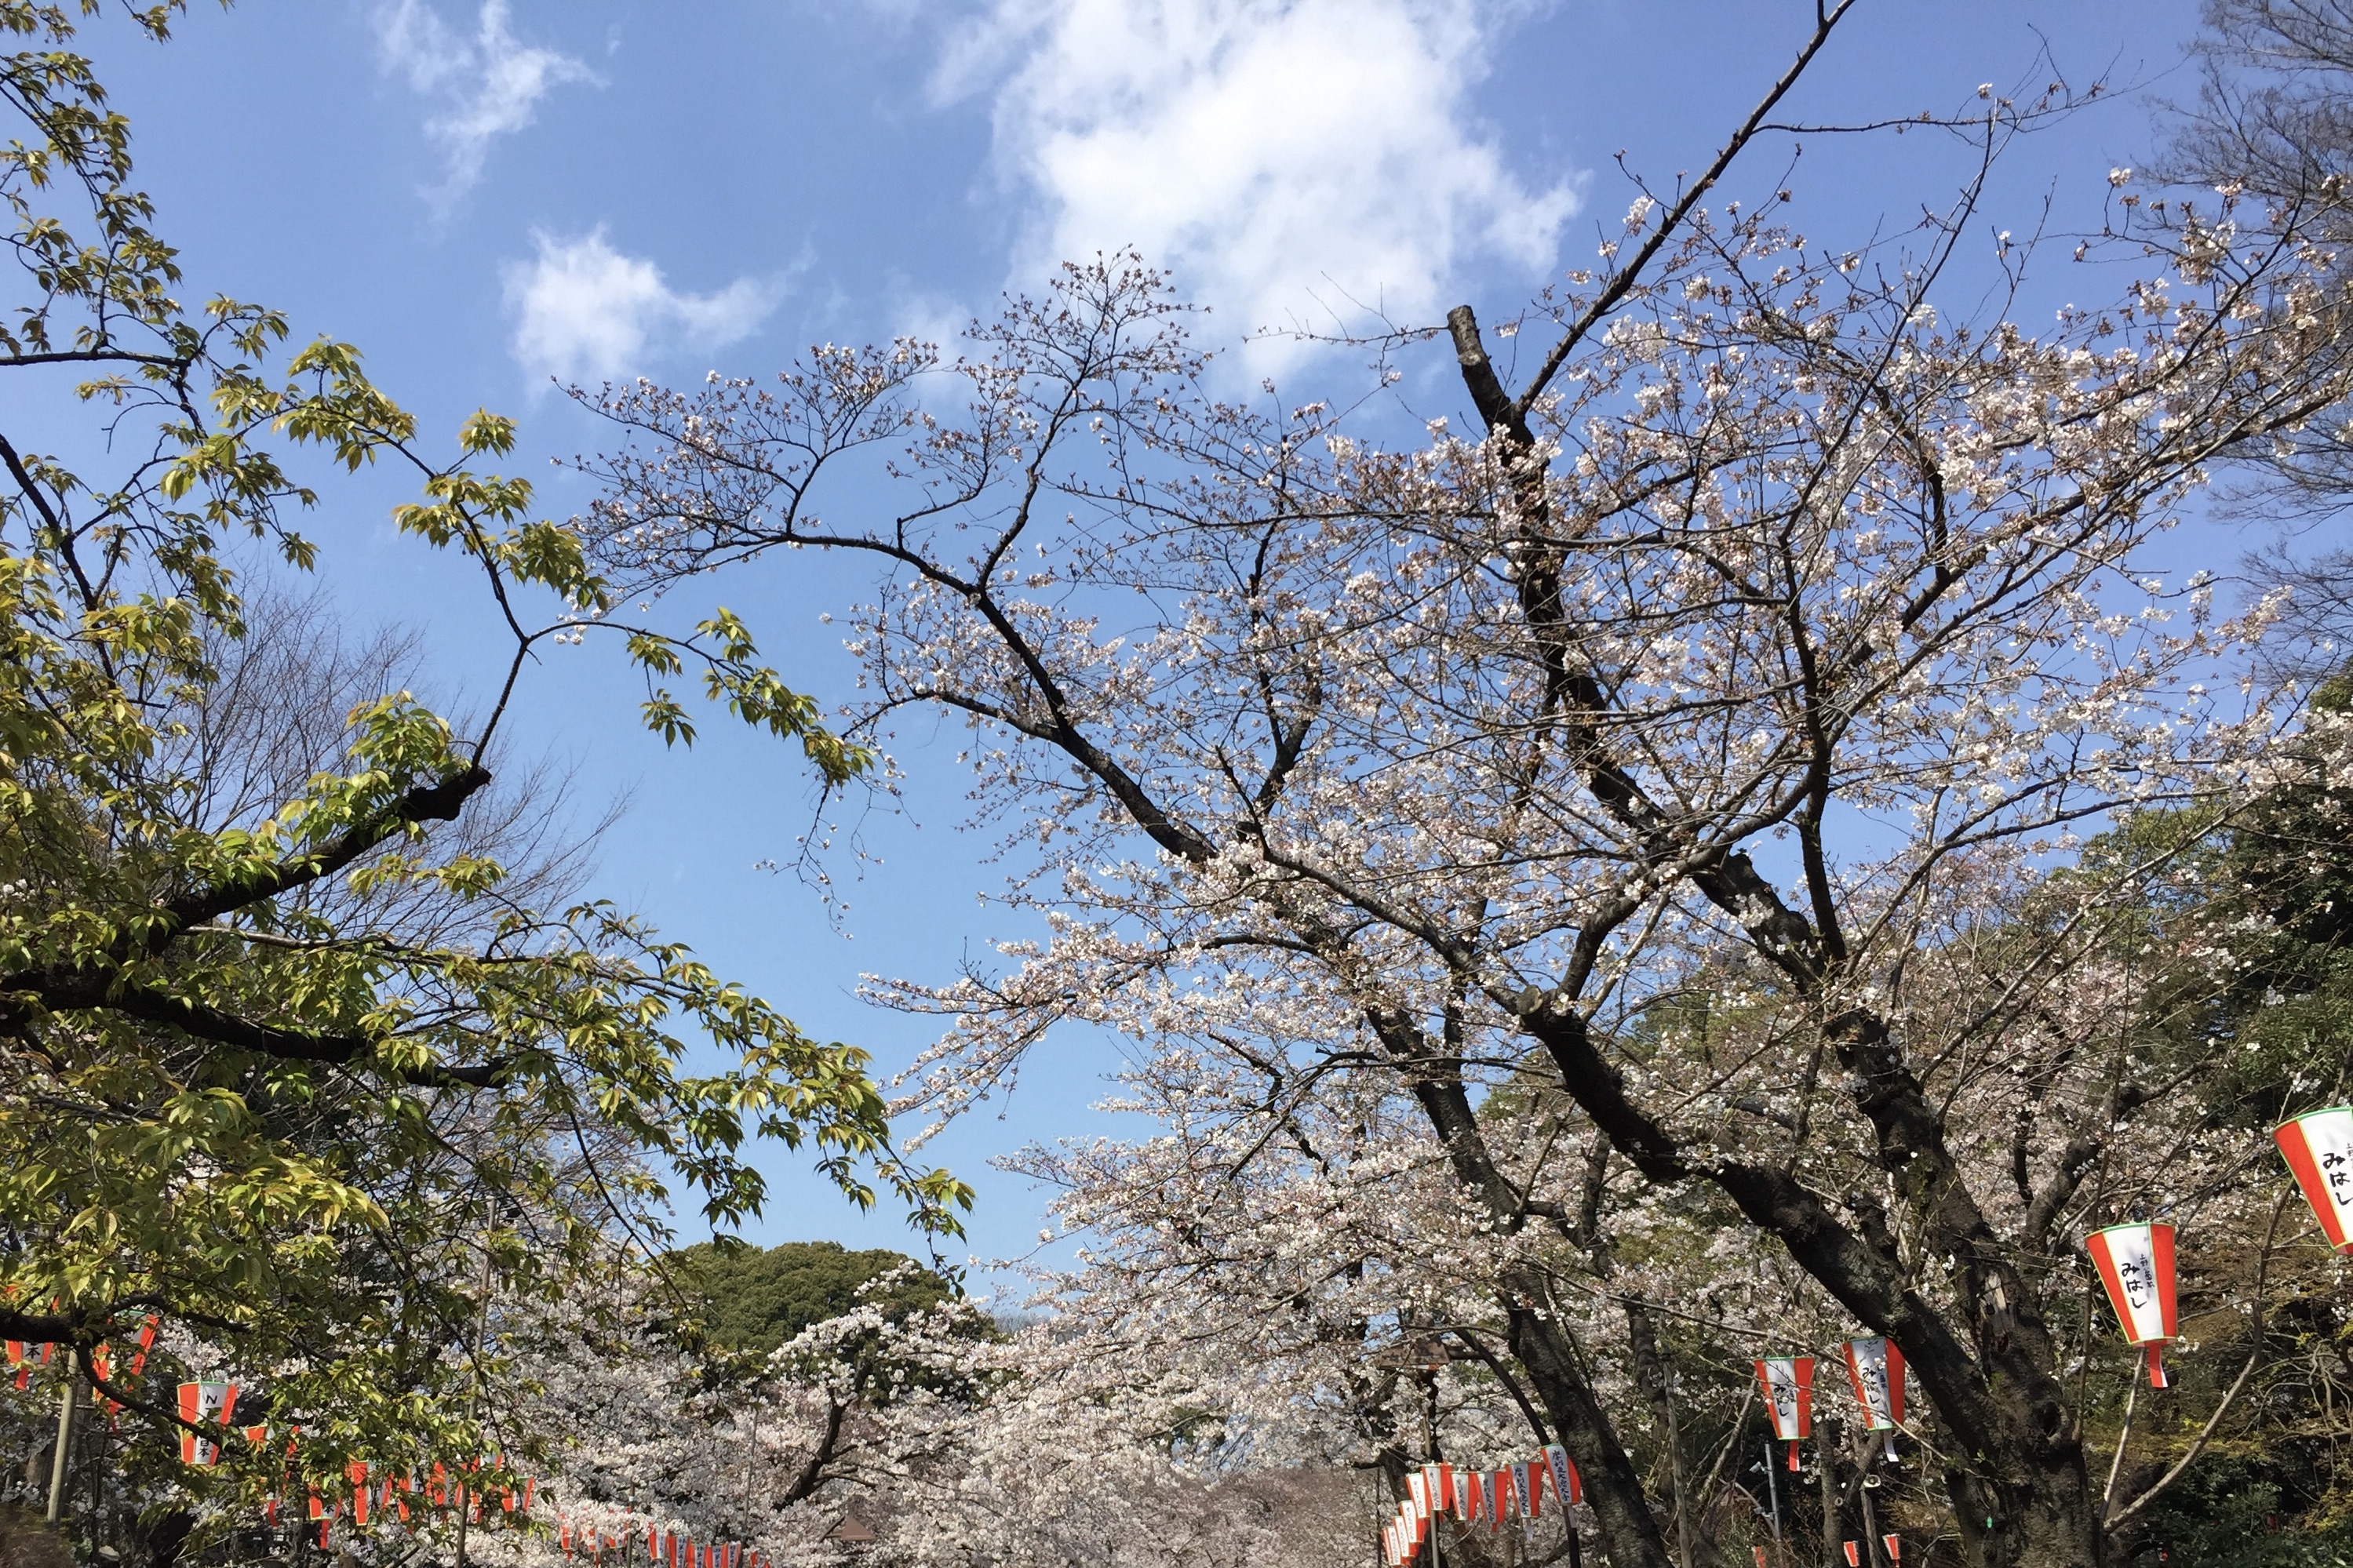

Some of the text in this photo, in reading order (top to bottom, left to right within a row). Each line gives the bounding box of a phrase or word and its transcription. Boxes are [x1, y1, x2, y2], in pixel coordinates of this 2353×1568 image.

[2322, 1152, 2353, 1206] みはし
[2121, 1263, 2147, 1309] みはし
[25, 1347, 41, 1359] 本
[1862, 1367, 1881, 1404] みはし
